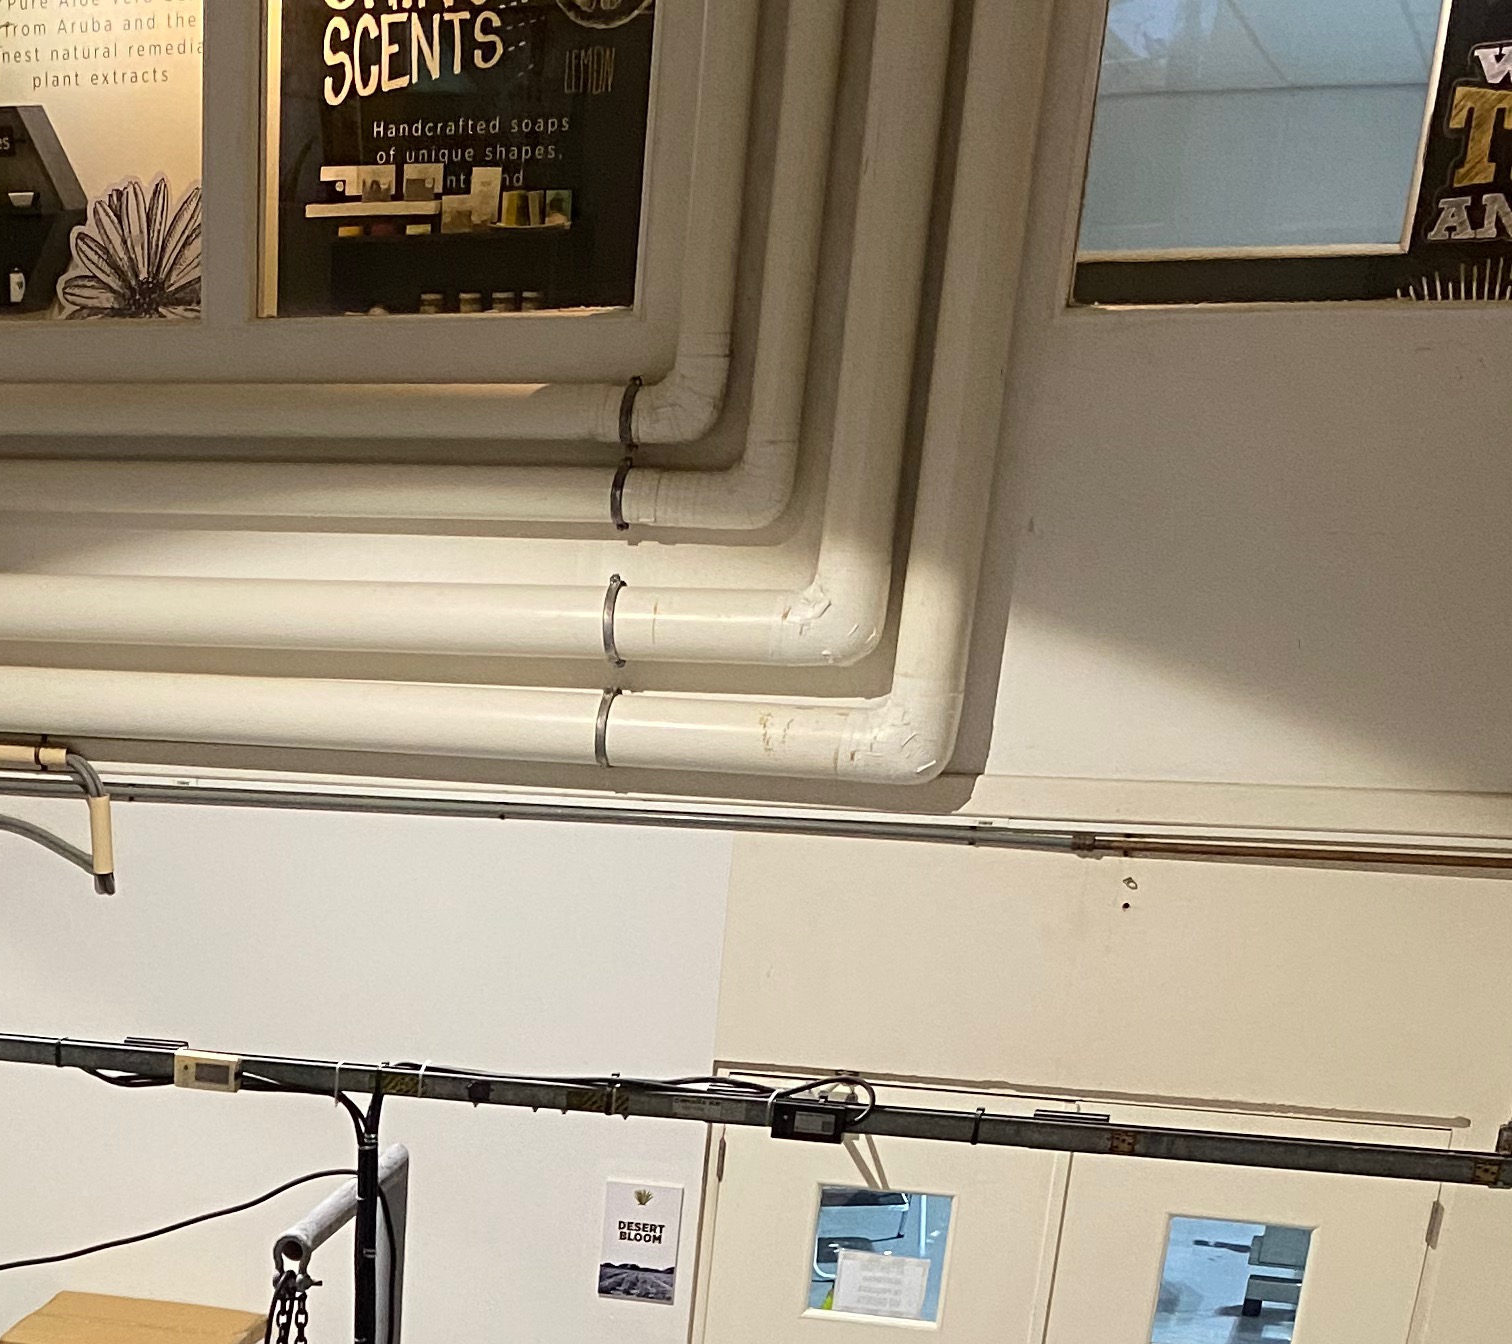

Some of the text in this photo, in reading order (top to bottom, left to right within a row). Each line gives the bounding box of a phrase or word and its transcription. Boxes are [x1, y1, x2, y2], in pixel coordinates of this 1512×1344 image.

[5, 12, 197, 38] from Aruba and the
[50, 43, 117, 61] natural
[128, 39, 203, 57] remedia
[324, 11, 503, 106] SCENTS
[32, 67, 169, 91] plant extracts
[564, 46, 615, 94] LEMON
[373, 116, 569, 138] Handcrafted soaps
[376, 147, 395, 164] of
[406, 146, 474, 165] unique
[618, 1221, 665, 1234] DESERT
[619, 1231, 662, 1244] BLOOM
